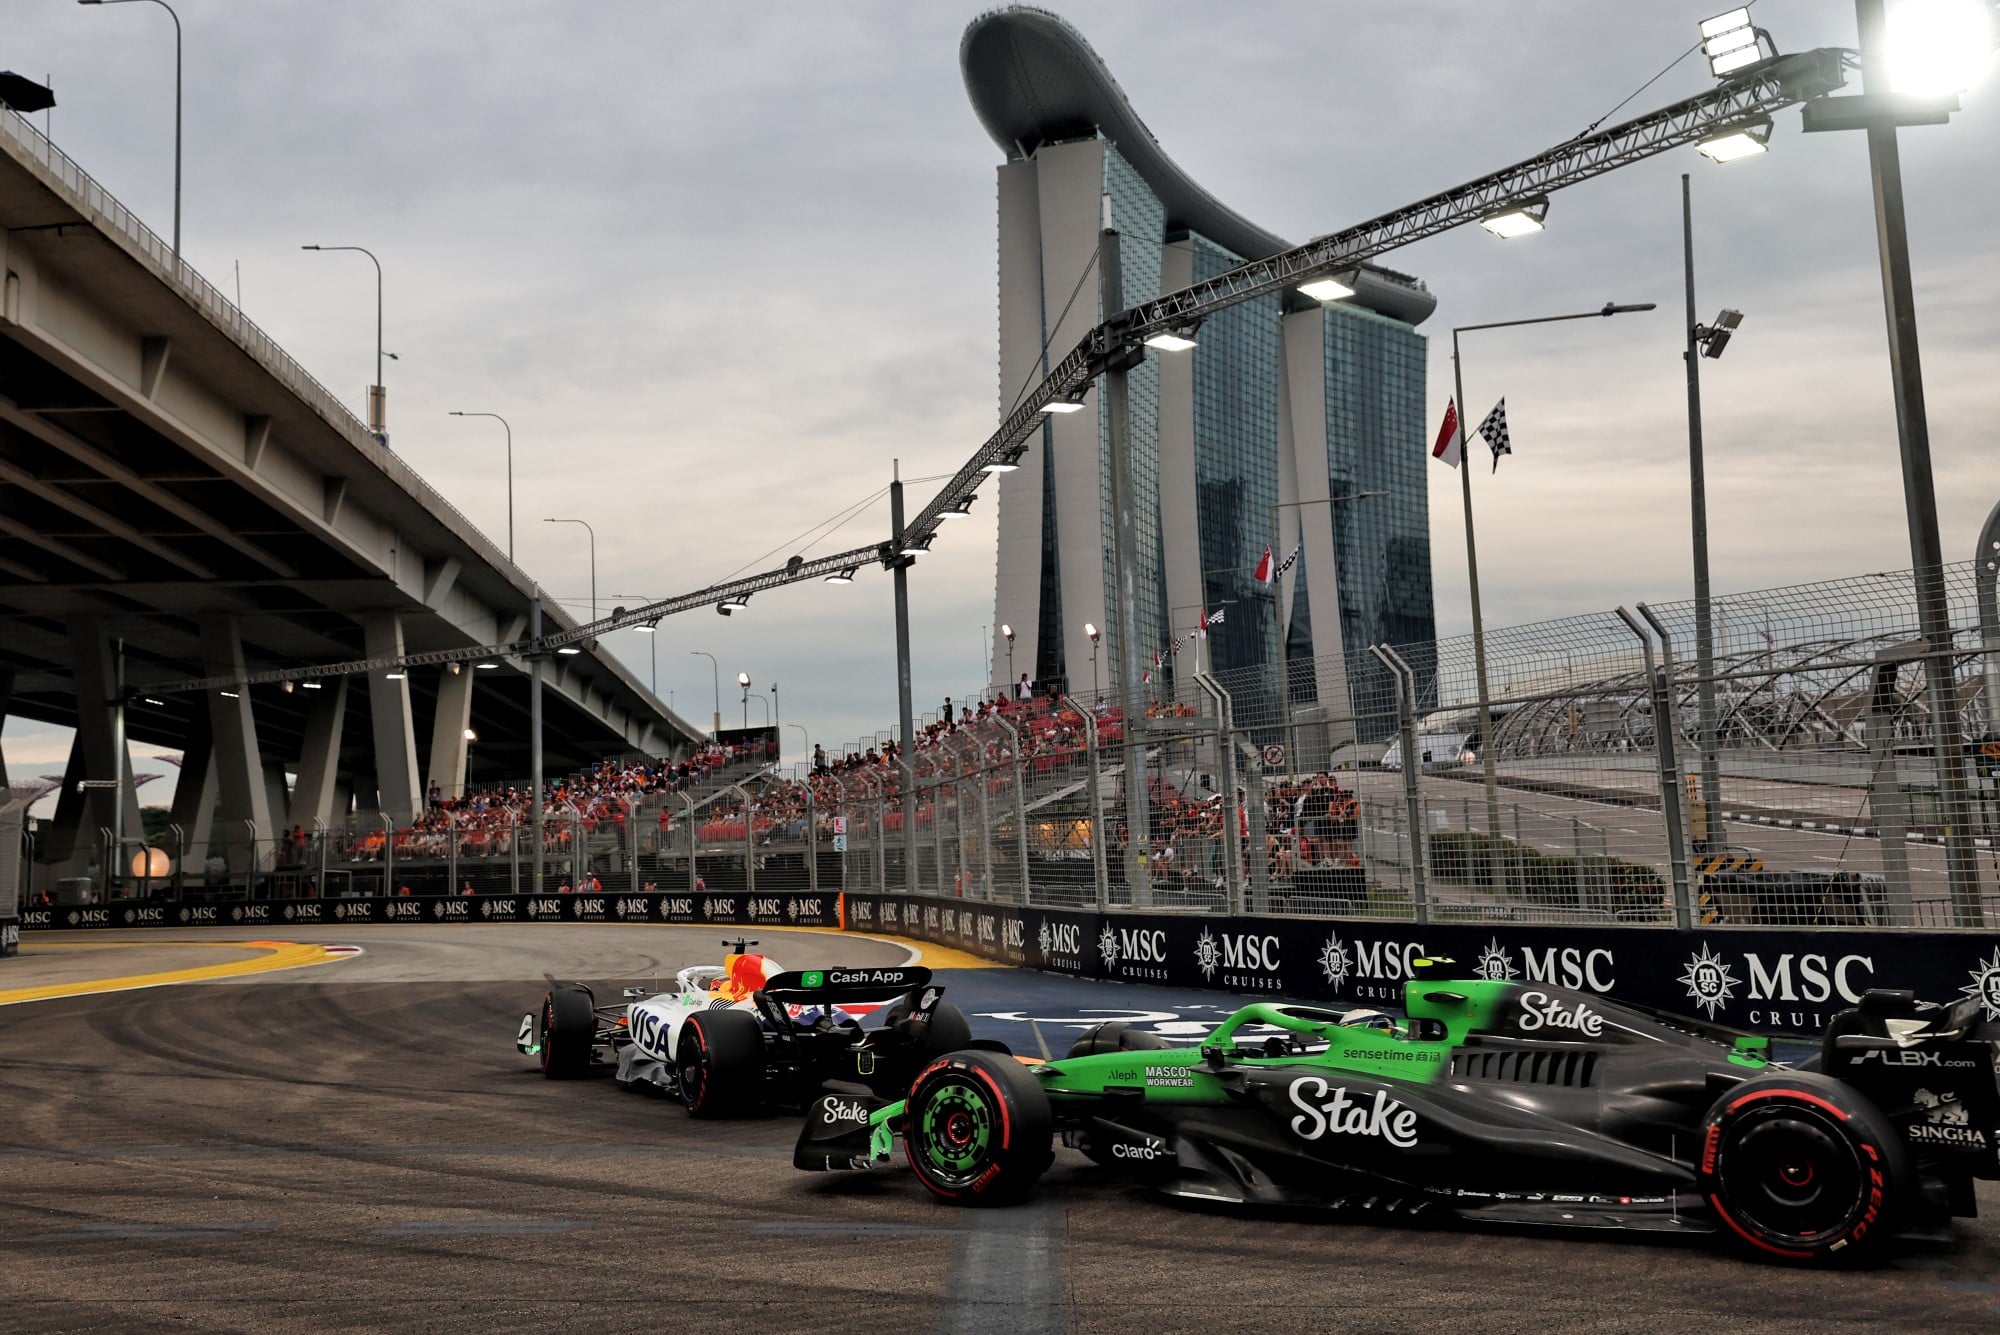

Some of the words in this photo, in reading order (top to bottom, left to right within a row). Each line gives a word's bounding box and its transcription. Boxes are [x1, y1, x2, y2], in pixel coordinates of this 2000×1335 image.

[192, 907, 217, 919] MSC
[244, 905, 269, 917] MSC
[296, 904, 322, 916] MSC
[347, 903, 372, 915] MSC
[396, 902, 421, 915] MSC
[446, 901, 469, 914] MSC
[493, 899, 516, 914] MSC
[538, 899, 561, 914] MSC
[584, 899, 605, 914] MSC
[627, 898, 648, 914] MSC
[671, 898, 693, 914] MSC
[714, 899, 735, 914] MSC
[758, 899, 781, 915] MSC
[799, 899, 822, 916] MSC
[857, 901, 872, 920] MSC
[24, 911, 51, 924] MSC
[82, 910, 109, 922] MSC
[137, 908, 164, 920] MSC
[1008, 918, 1025, 947] MSC
[1052, 923, 1080, 955] MSC
[1120, 928, 1167, 962] MSC
[1222, 933, 1280, 971] MSC
[1052, 957, 1081, 970] CRUISES
[1354, 940, 1425, 980] MSC
[829, 971, 870, 983] Cash
[871, 970, 904, 985] App
[1122, 966, 1168, 980] CRUISES
[1520, 947, 1615, 993] MSC
[1224, 975, 1282, 990] CRUISES
[1743, 953, 1874, 1005] MSC
[1519, 991, 1603, 1037] Stake
[632, 1006, 673, 1062] VISA
[1343, 1049, 1414, 1061] sensetime
[1881, 1050, 1976, 1068] LBX.com
[1108, 1070, 1137, 1082] Aleph
[1145, 1066, 1192, 1078] MASCOT
[1146, 1078, 1194, 1088] WORKWEAR
[823, 1096, 868, 1125] Stake
[1289, 1076, 1418, 1148] Stake
[1908, 1124, 1986, 1144] SINGHA
[1112, 1143, 1155, 1161] Claro
[1852, 1167, 1884, 1241] ZERO
